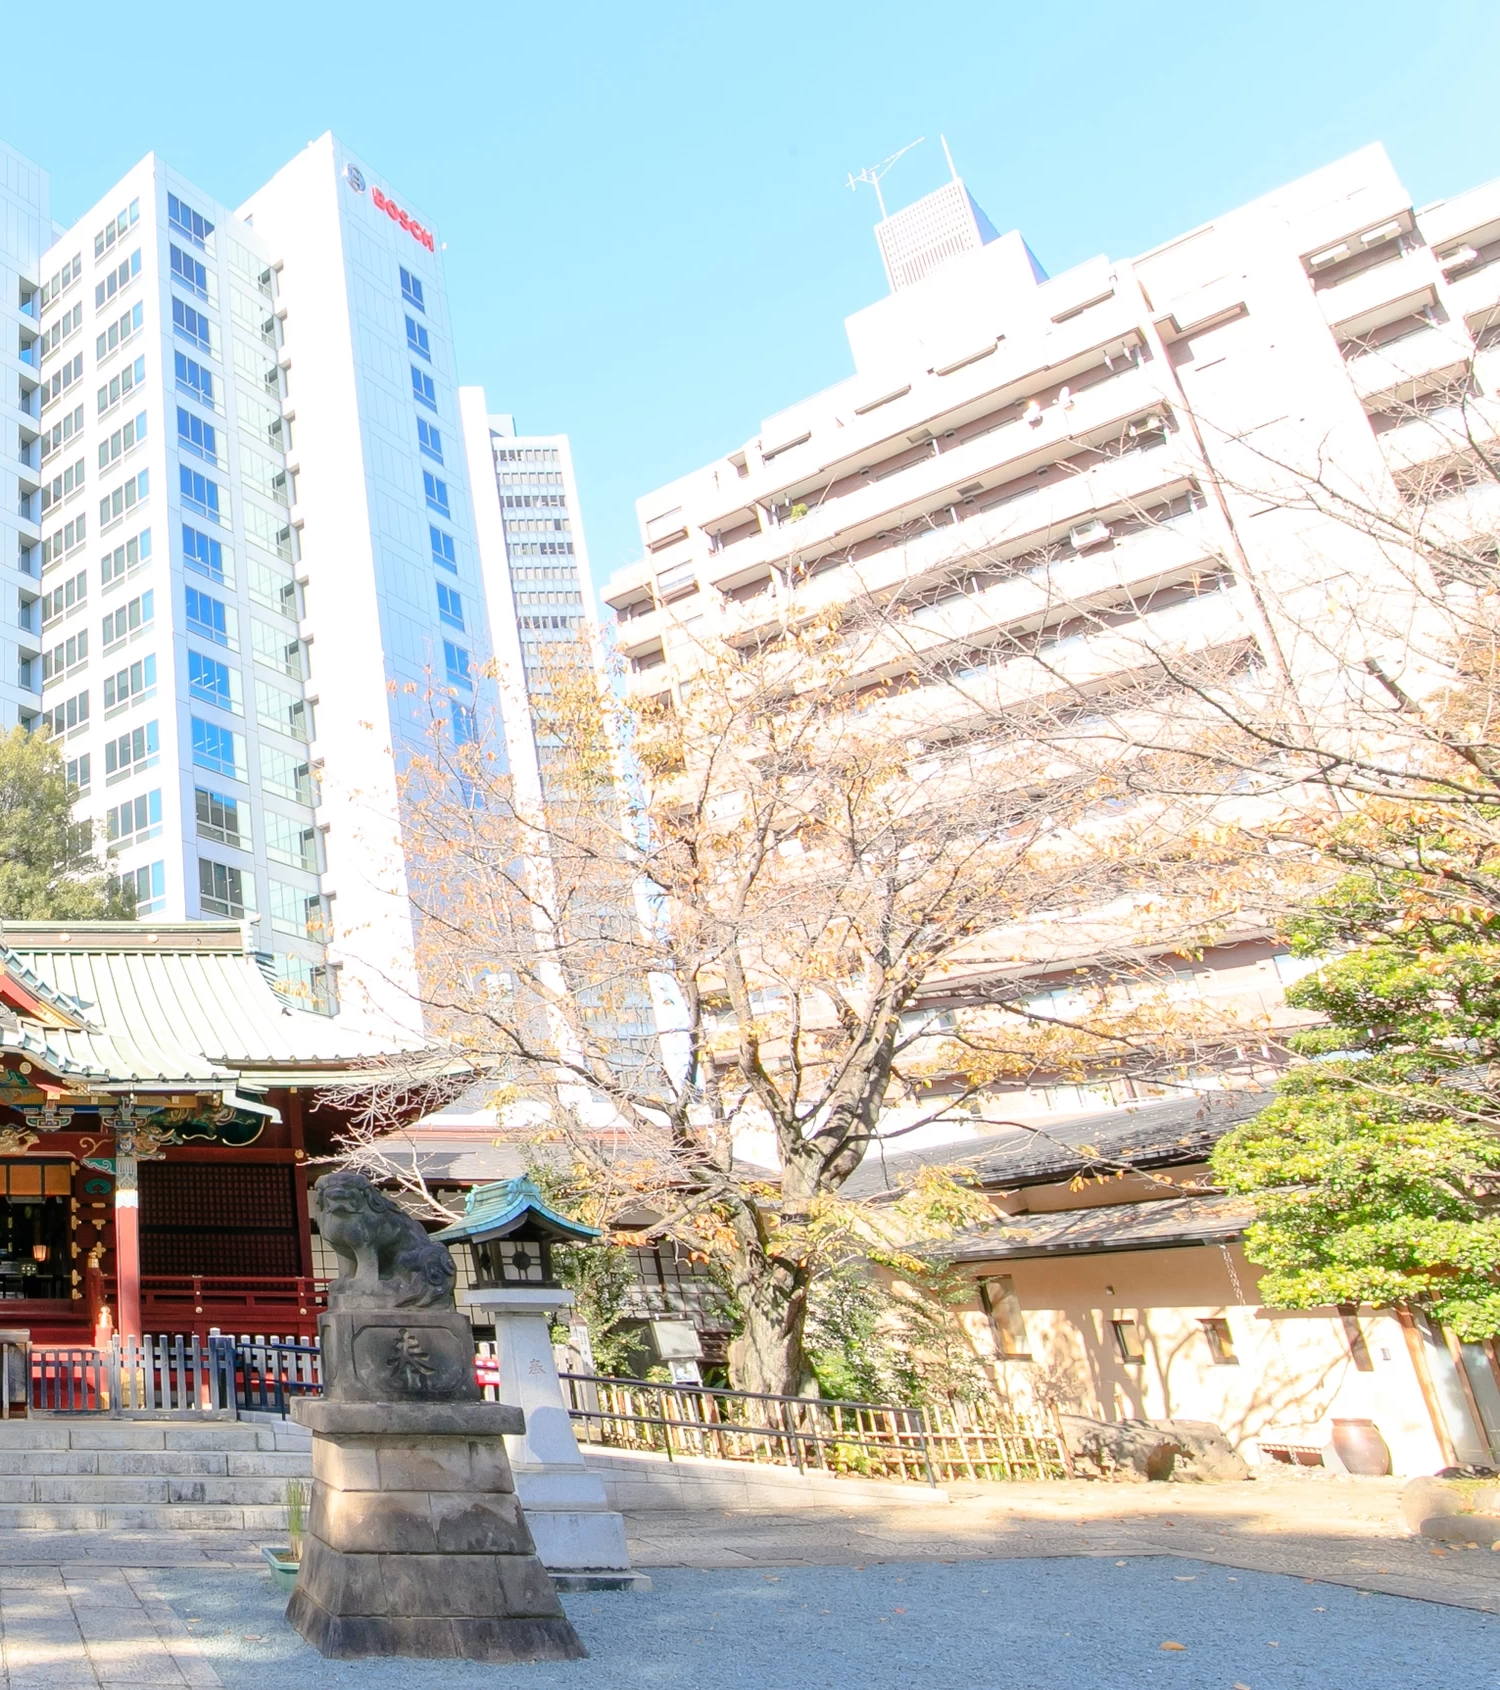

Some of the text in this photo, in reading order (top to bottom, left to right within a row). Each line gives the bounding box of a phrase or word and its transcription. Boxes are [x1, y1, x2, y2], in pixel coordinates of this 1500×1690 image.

[371, 186, 435, 253] BOSCH
[386, 1328, 437, 1391] 奉
[529, 1358, 546, 1379] 奉
